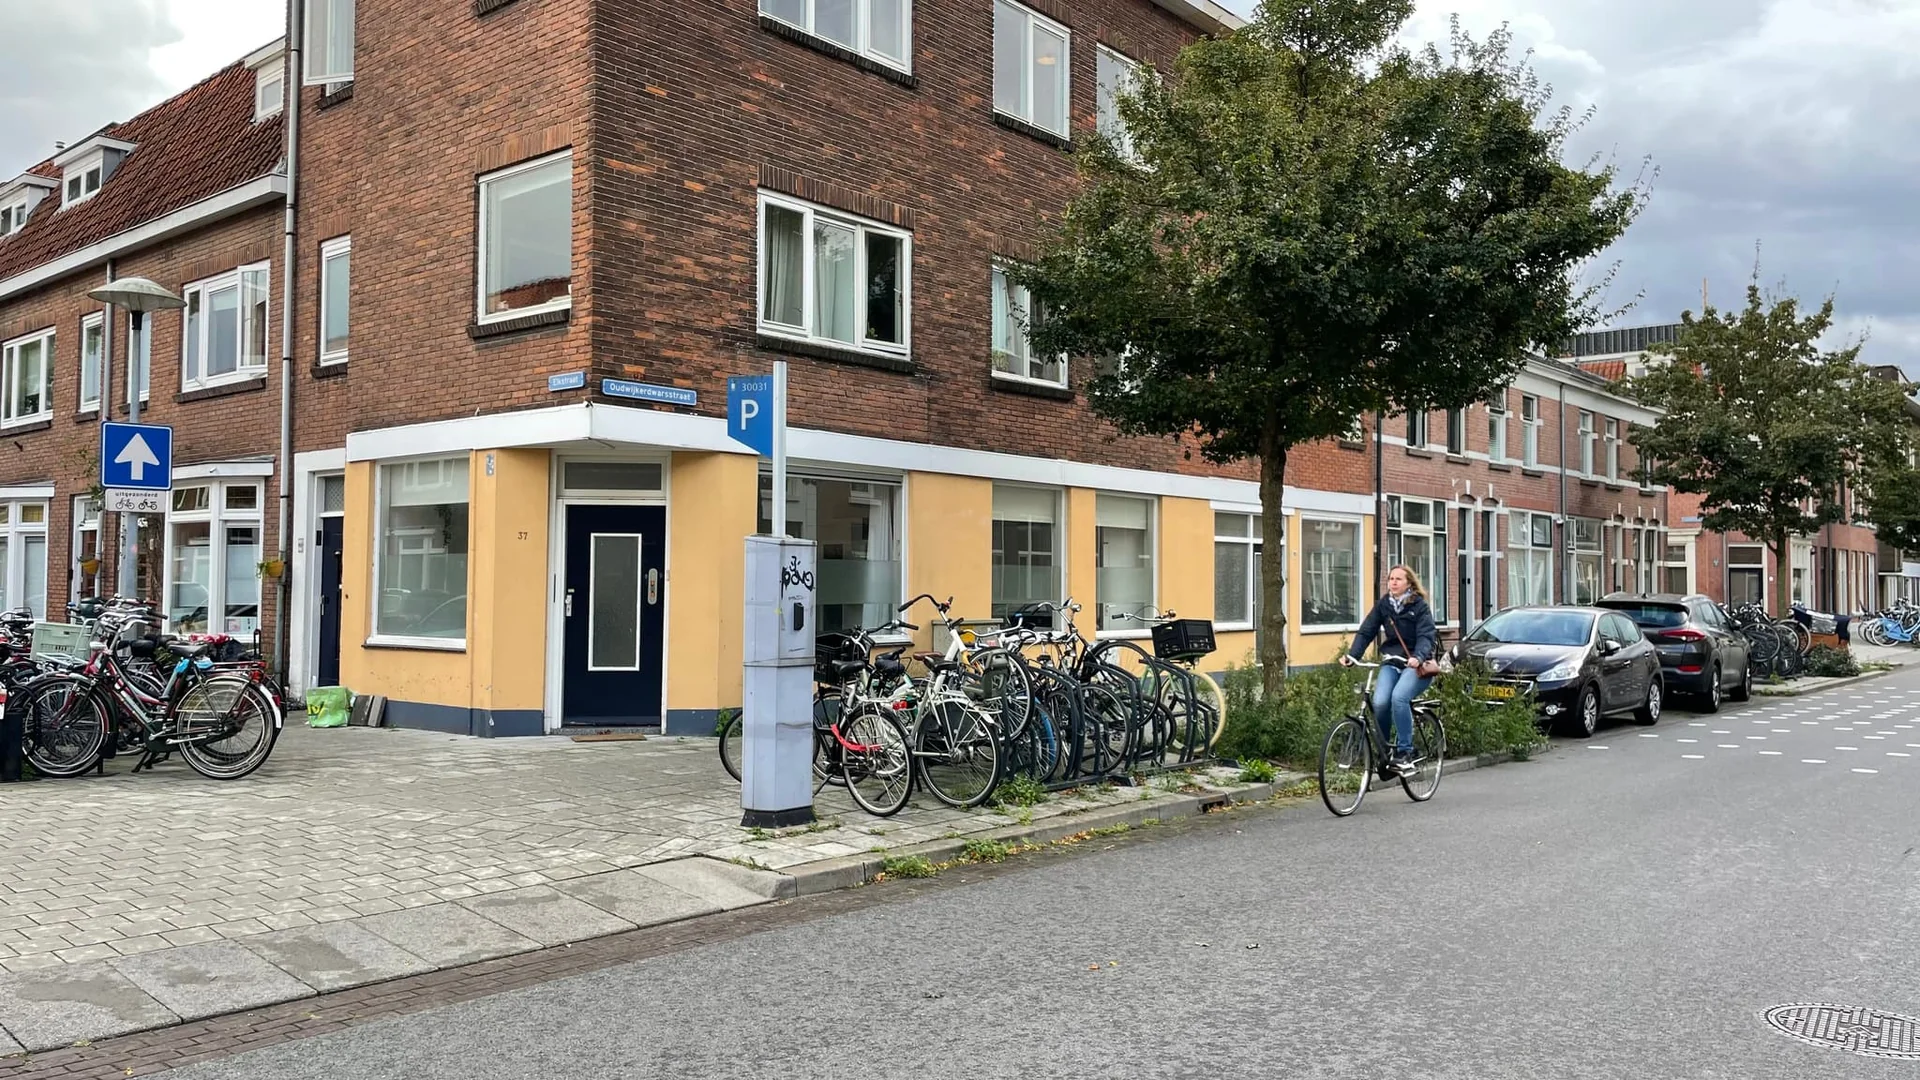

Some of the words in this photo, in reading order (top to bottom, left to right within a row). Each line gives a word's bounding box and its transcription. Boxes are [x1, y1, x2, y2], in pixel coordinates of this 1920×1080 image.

[552, 376, 579, 386] Elkstraat
[609, 382, 691, 400] Oudwijkerdwarsstraat
[741, 382, 767, 391] 30031
[741, 399, 759, 430] P
[517, 531, 528, 541] 37
